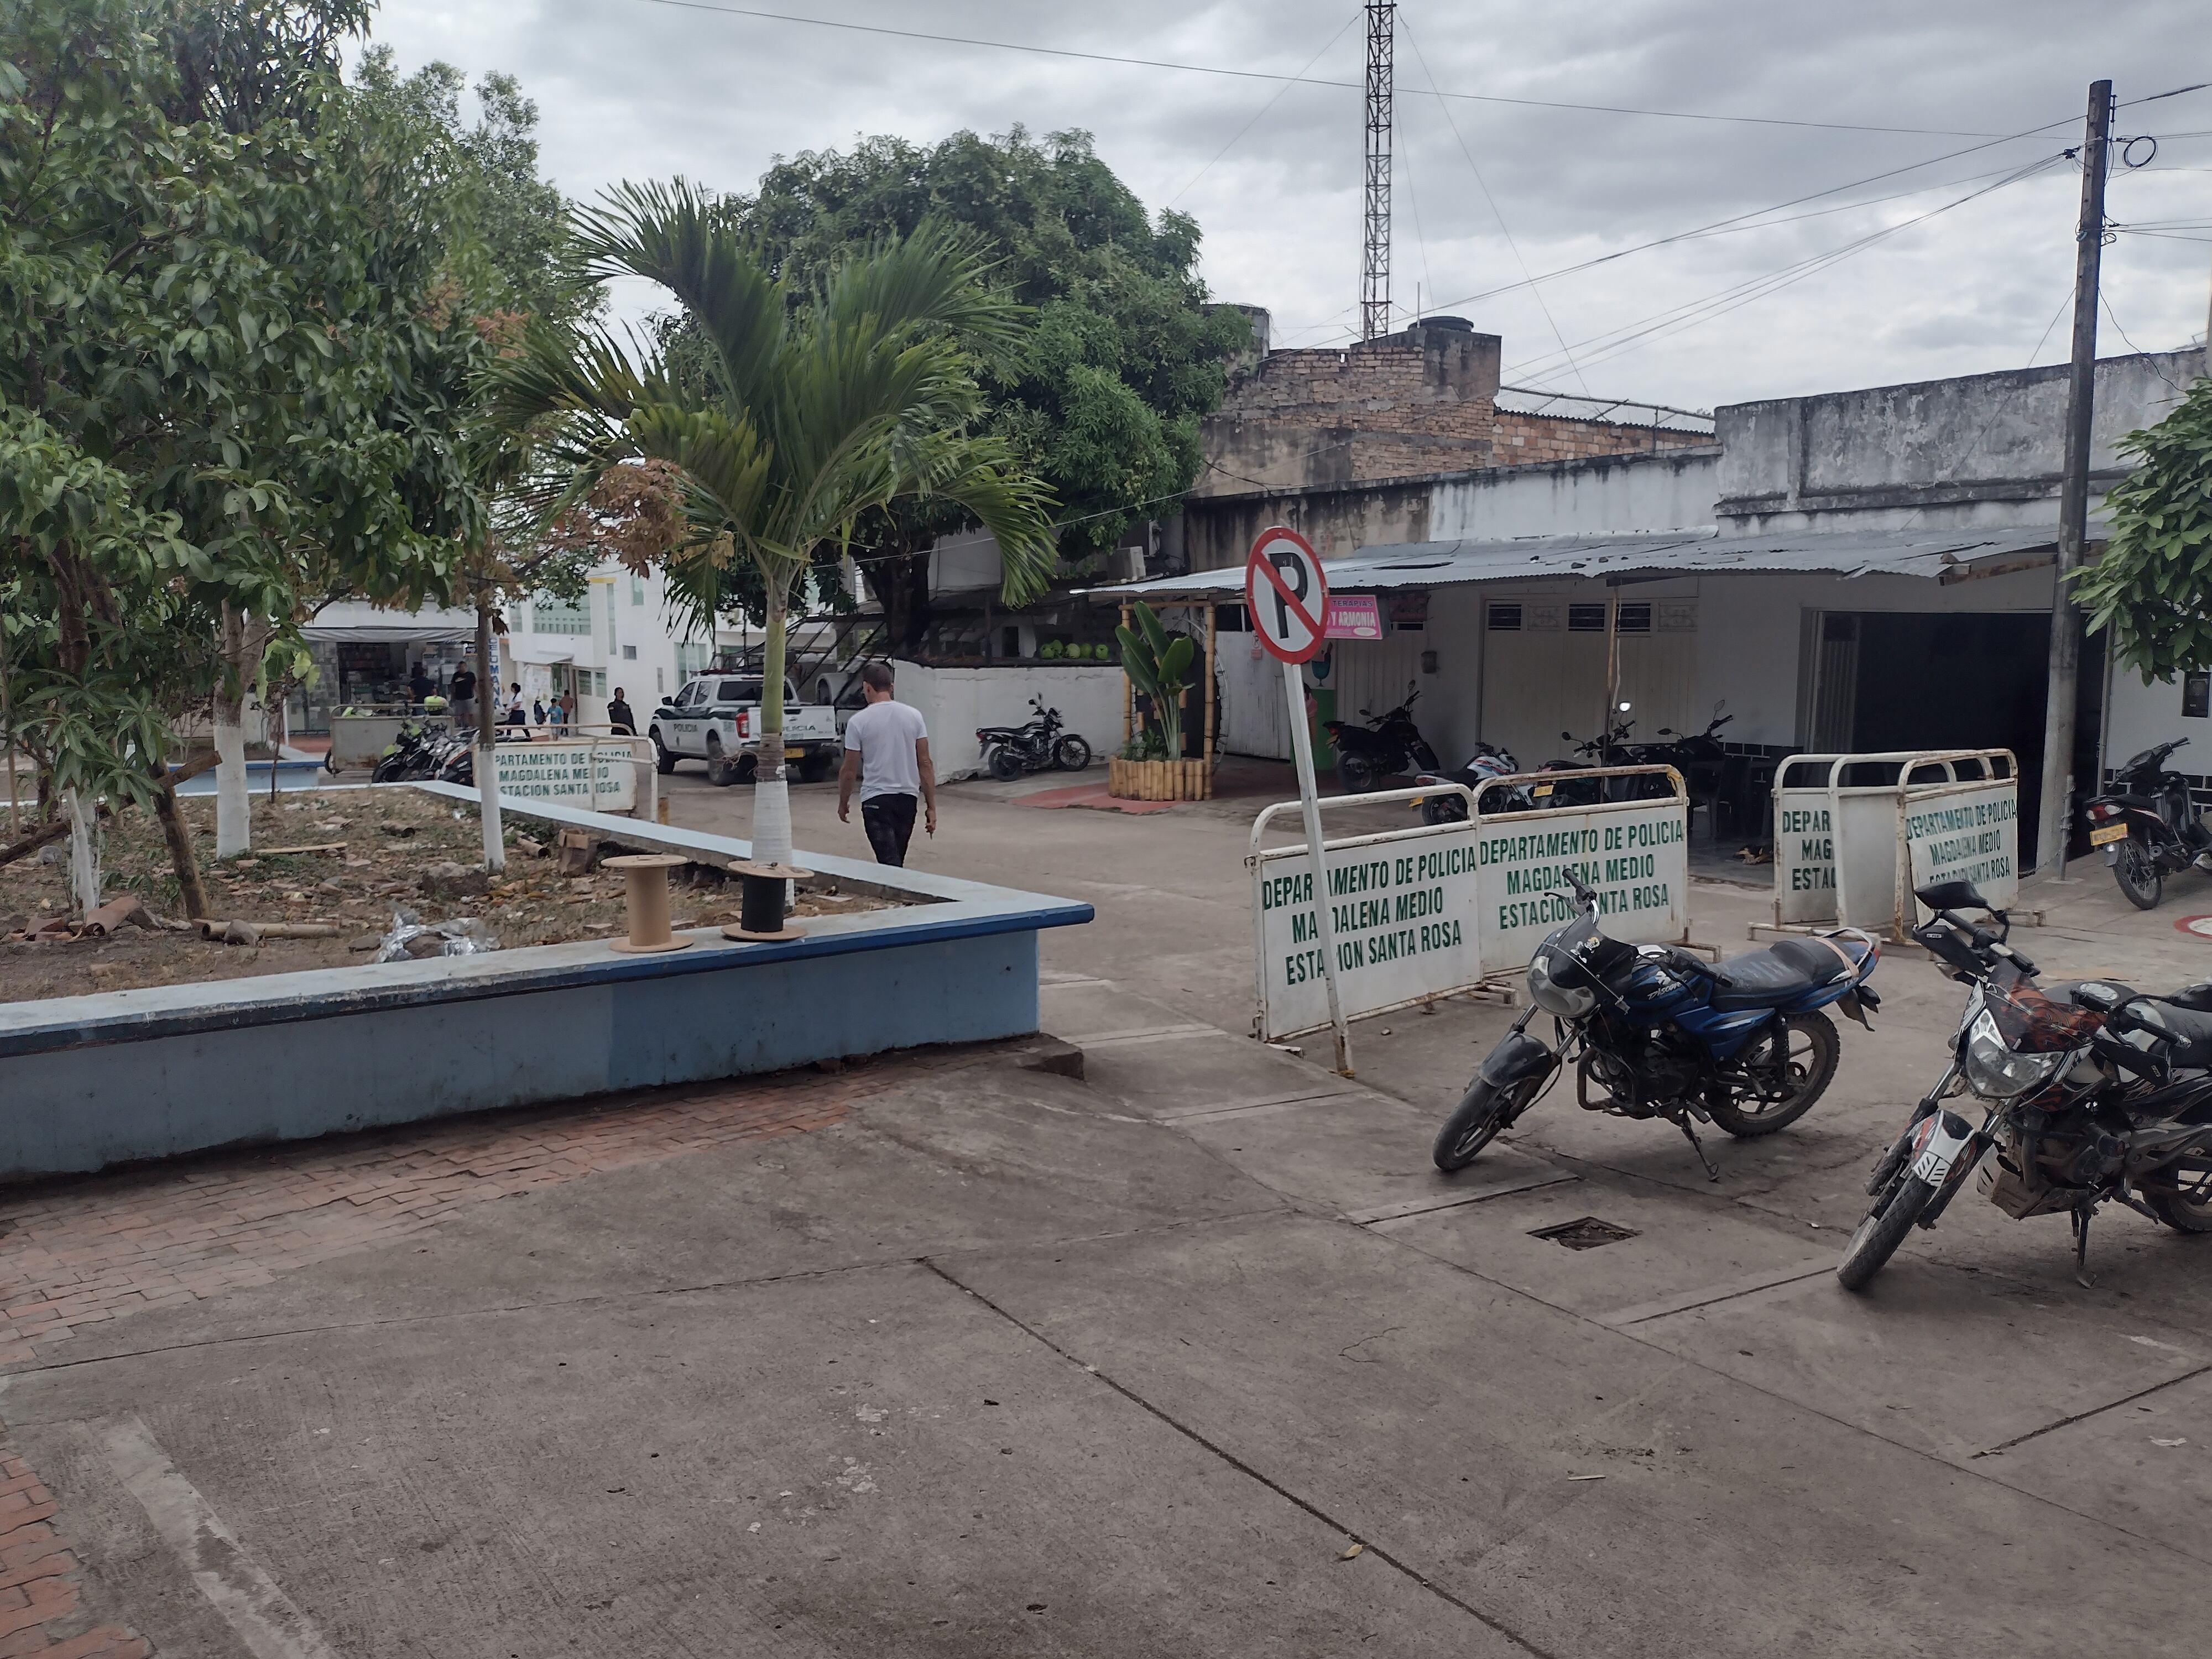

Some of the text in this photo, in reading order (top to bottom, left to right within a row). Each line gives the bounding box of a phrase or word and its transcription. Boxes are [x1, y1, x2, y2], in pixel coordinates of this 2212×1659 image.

[1268, 552, 1307, 639] P
[1339, 611, 1375, 627] ARMONIA
[673, 723, 697, 733] POLICIA
[495, 753, 566, 767] PARTAMENTO
[571, 752, 585, 764] DE
[499, 767, 609, 782] MAGDALENA MEIO
[500, 781, 620, 797] STACION SANTA OSA
[1782, 810, 1831, 833] DEPAR
[1906, 799, 2017, 841] DEPARTAMENTO DE POLICIA
[1479, 819, 1684, 866] DEPARTAMENTO DE POLICIA
[1801, 838, 1832, 861] MAG
[1979, 829, 2001, 855] MEDIO
[1395, 857, 1413, 886] DE
[1418, 846, 1477, 882] POLICIA
[1606, 853, 1654, 883] MEDIO
[1991, 855, 2011, 880] ROSA
[1598, 889, 1629, 915] NTA
[1632, 883, 1669, 911] ROSA
[1292, 886, 1443, 944] MADALENA MEDIO
[1285, 919, 1463, 986] ESTAION SANTA ROSA
